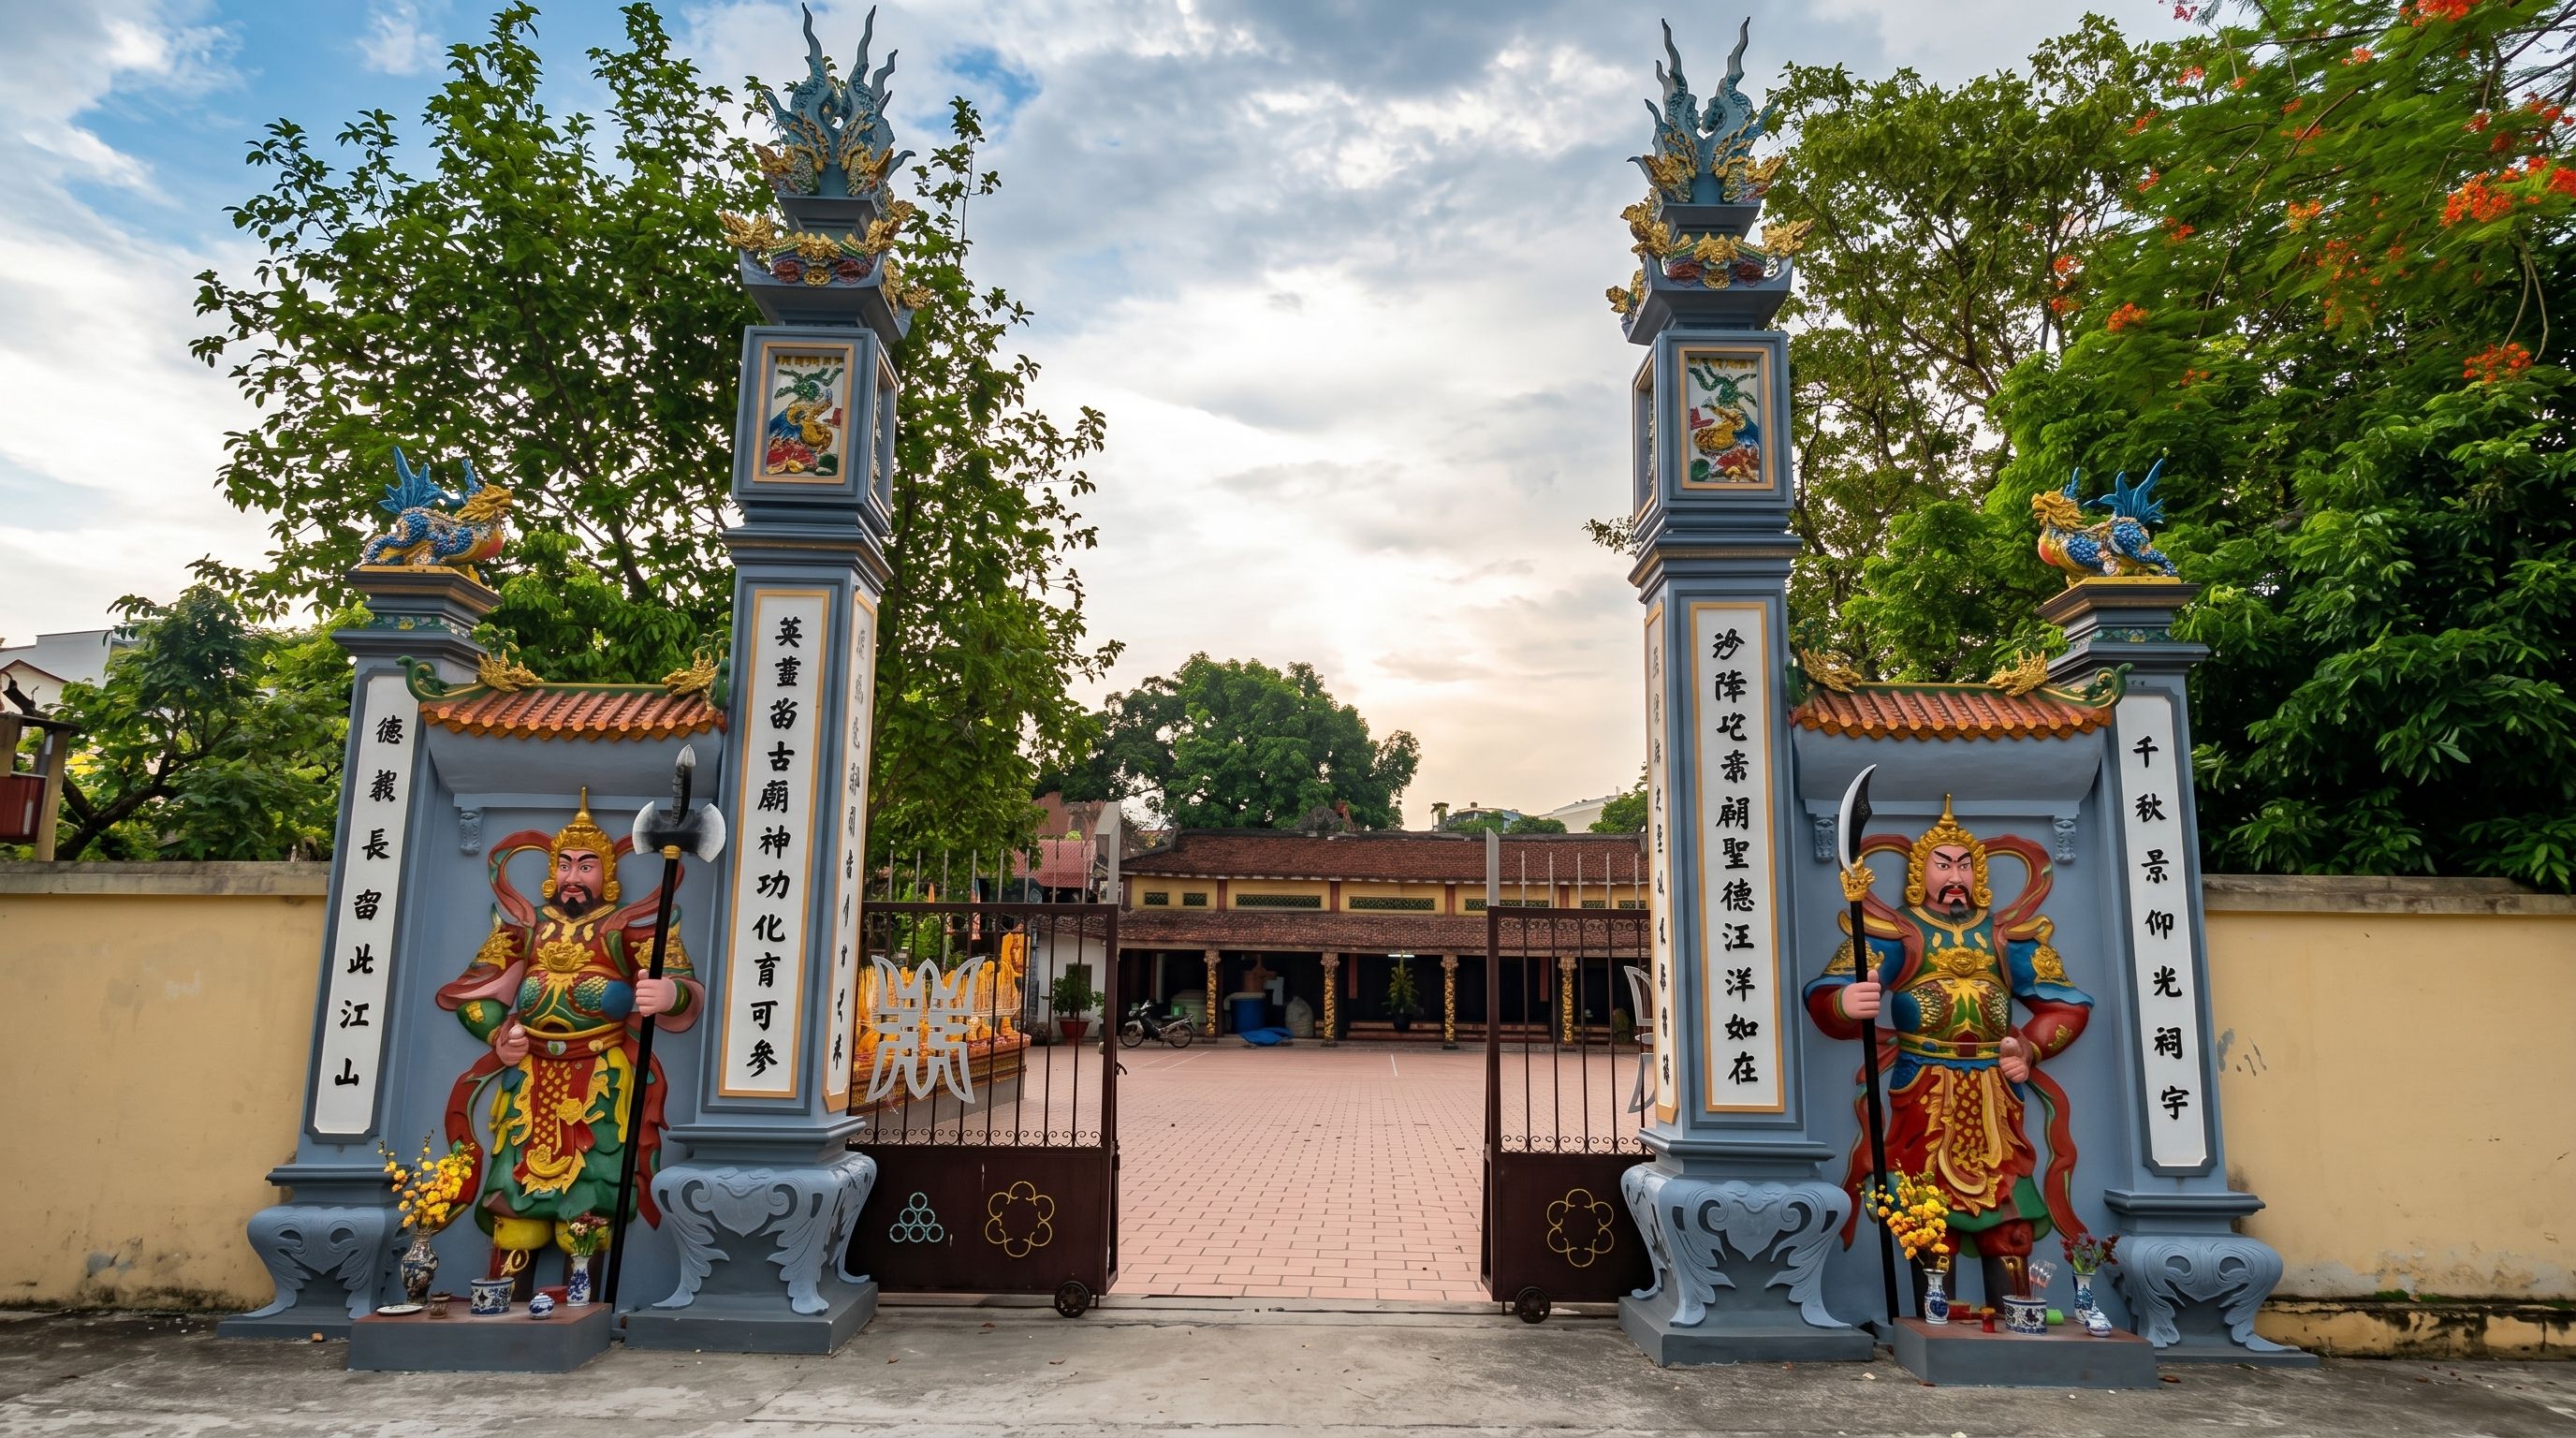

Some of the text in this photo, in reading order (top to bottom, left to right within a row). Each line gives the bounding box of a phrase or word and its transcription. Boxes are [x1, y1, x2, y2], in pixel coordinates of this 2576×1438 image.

[2132, 735, 2190, 1121] 千秋景仰光祠宇
